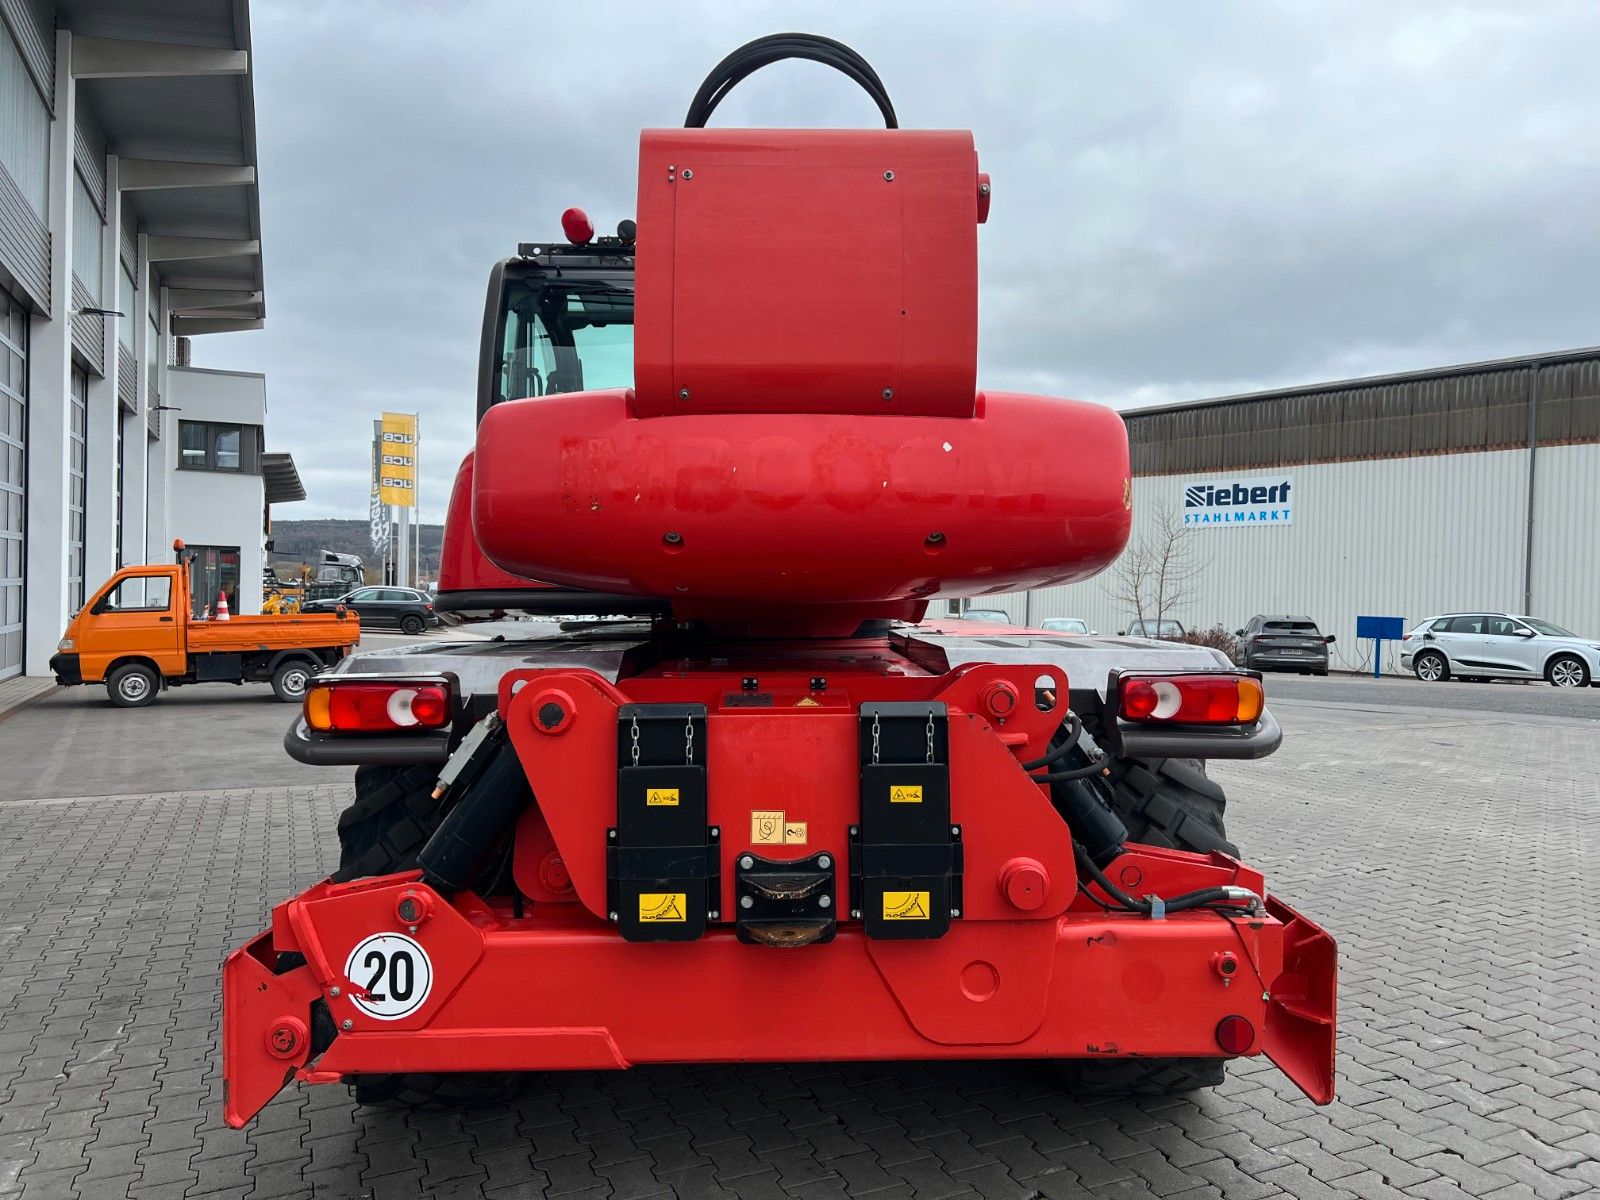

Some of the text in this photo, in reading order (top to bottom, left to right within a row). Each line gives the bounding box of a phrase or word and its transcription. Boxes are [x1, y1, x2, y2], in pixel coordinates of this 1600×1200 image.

[1186, 481, 1291, 507] Siebert
[1185, 510, 1290, 524] STAHLMARKT
[364, 951, 414, 1001] 20
